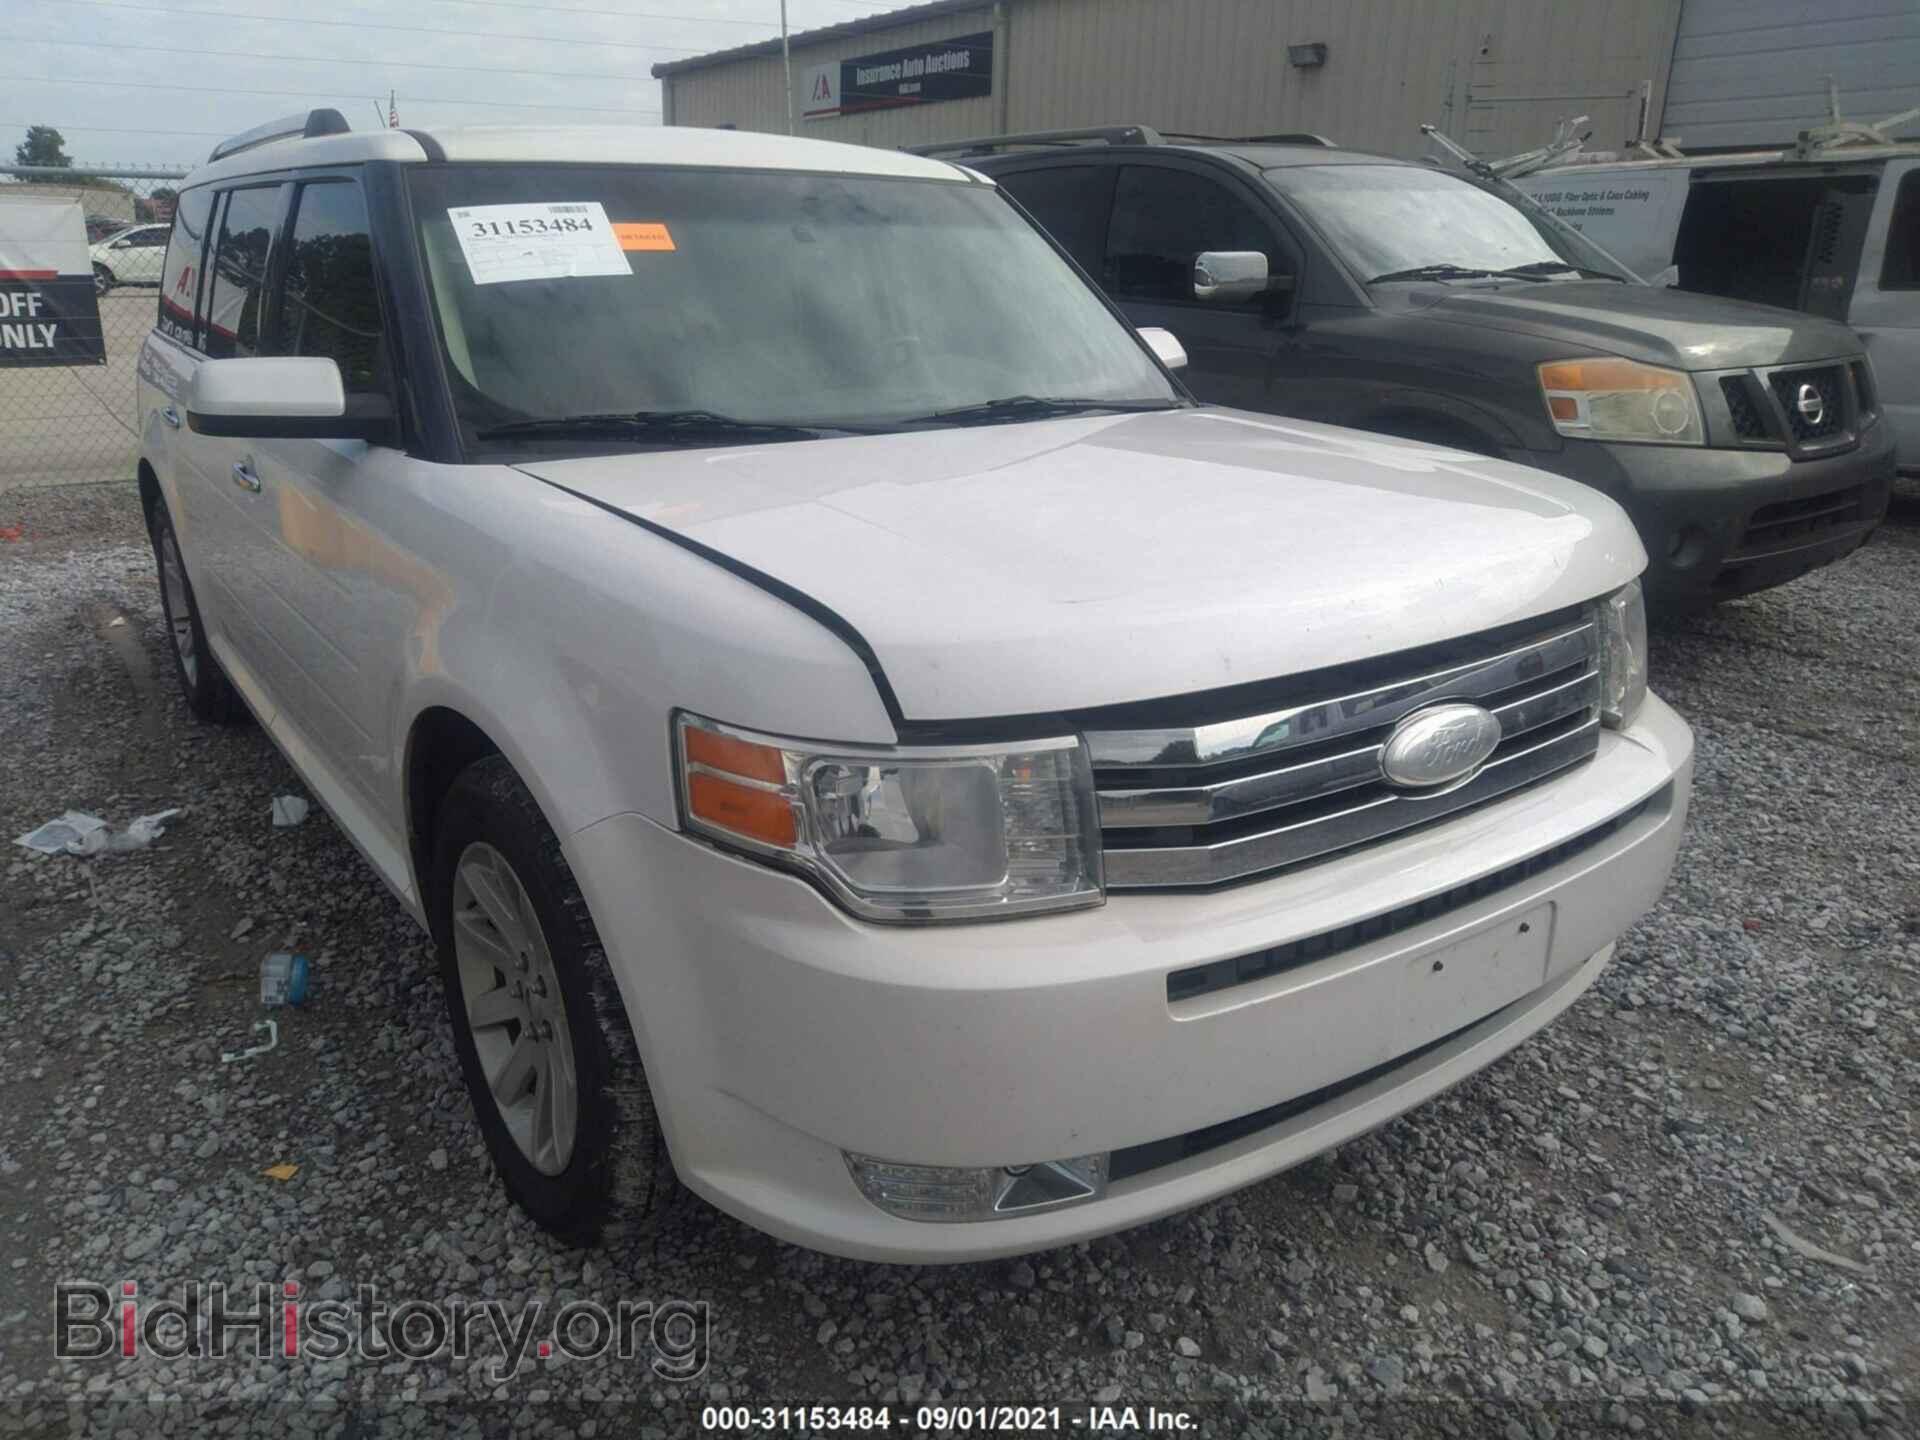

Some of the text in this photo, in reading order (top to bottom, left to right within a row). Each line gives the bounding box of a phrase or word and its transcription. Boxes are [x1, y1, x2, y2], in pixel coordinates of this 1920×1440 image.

[902, 57, 924, 78] Auto
[925, 50, 970, 73] Auctions
[471, 217, 593, 238] 31153484
[0, 324, 57, 349] NLY
[1424, 722, 1484, 768] Ford
